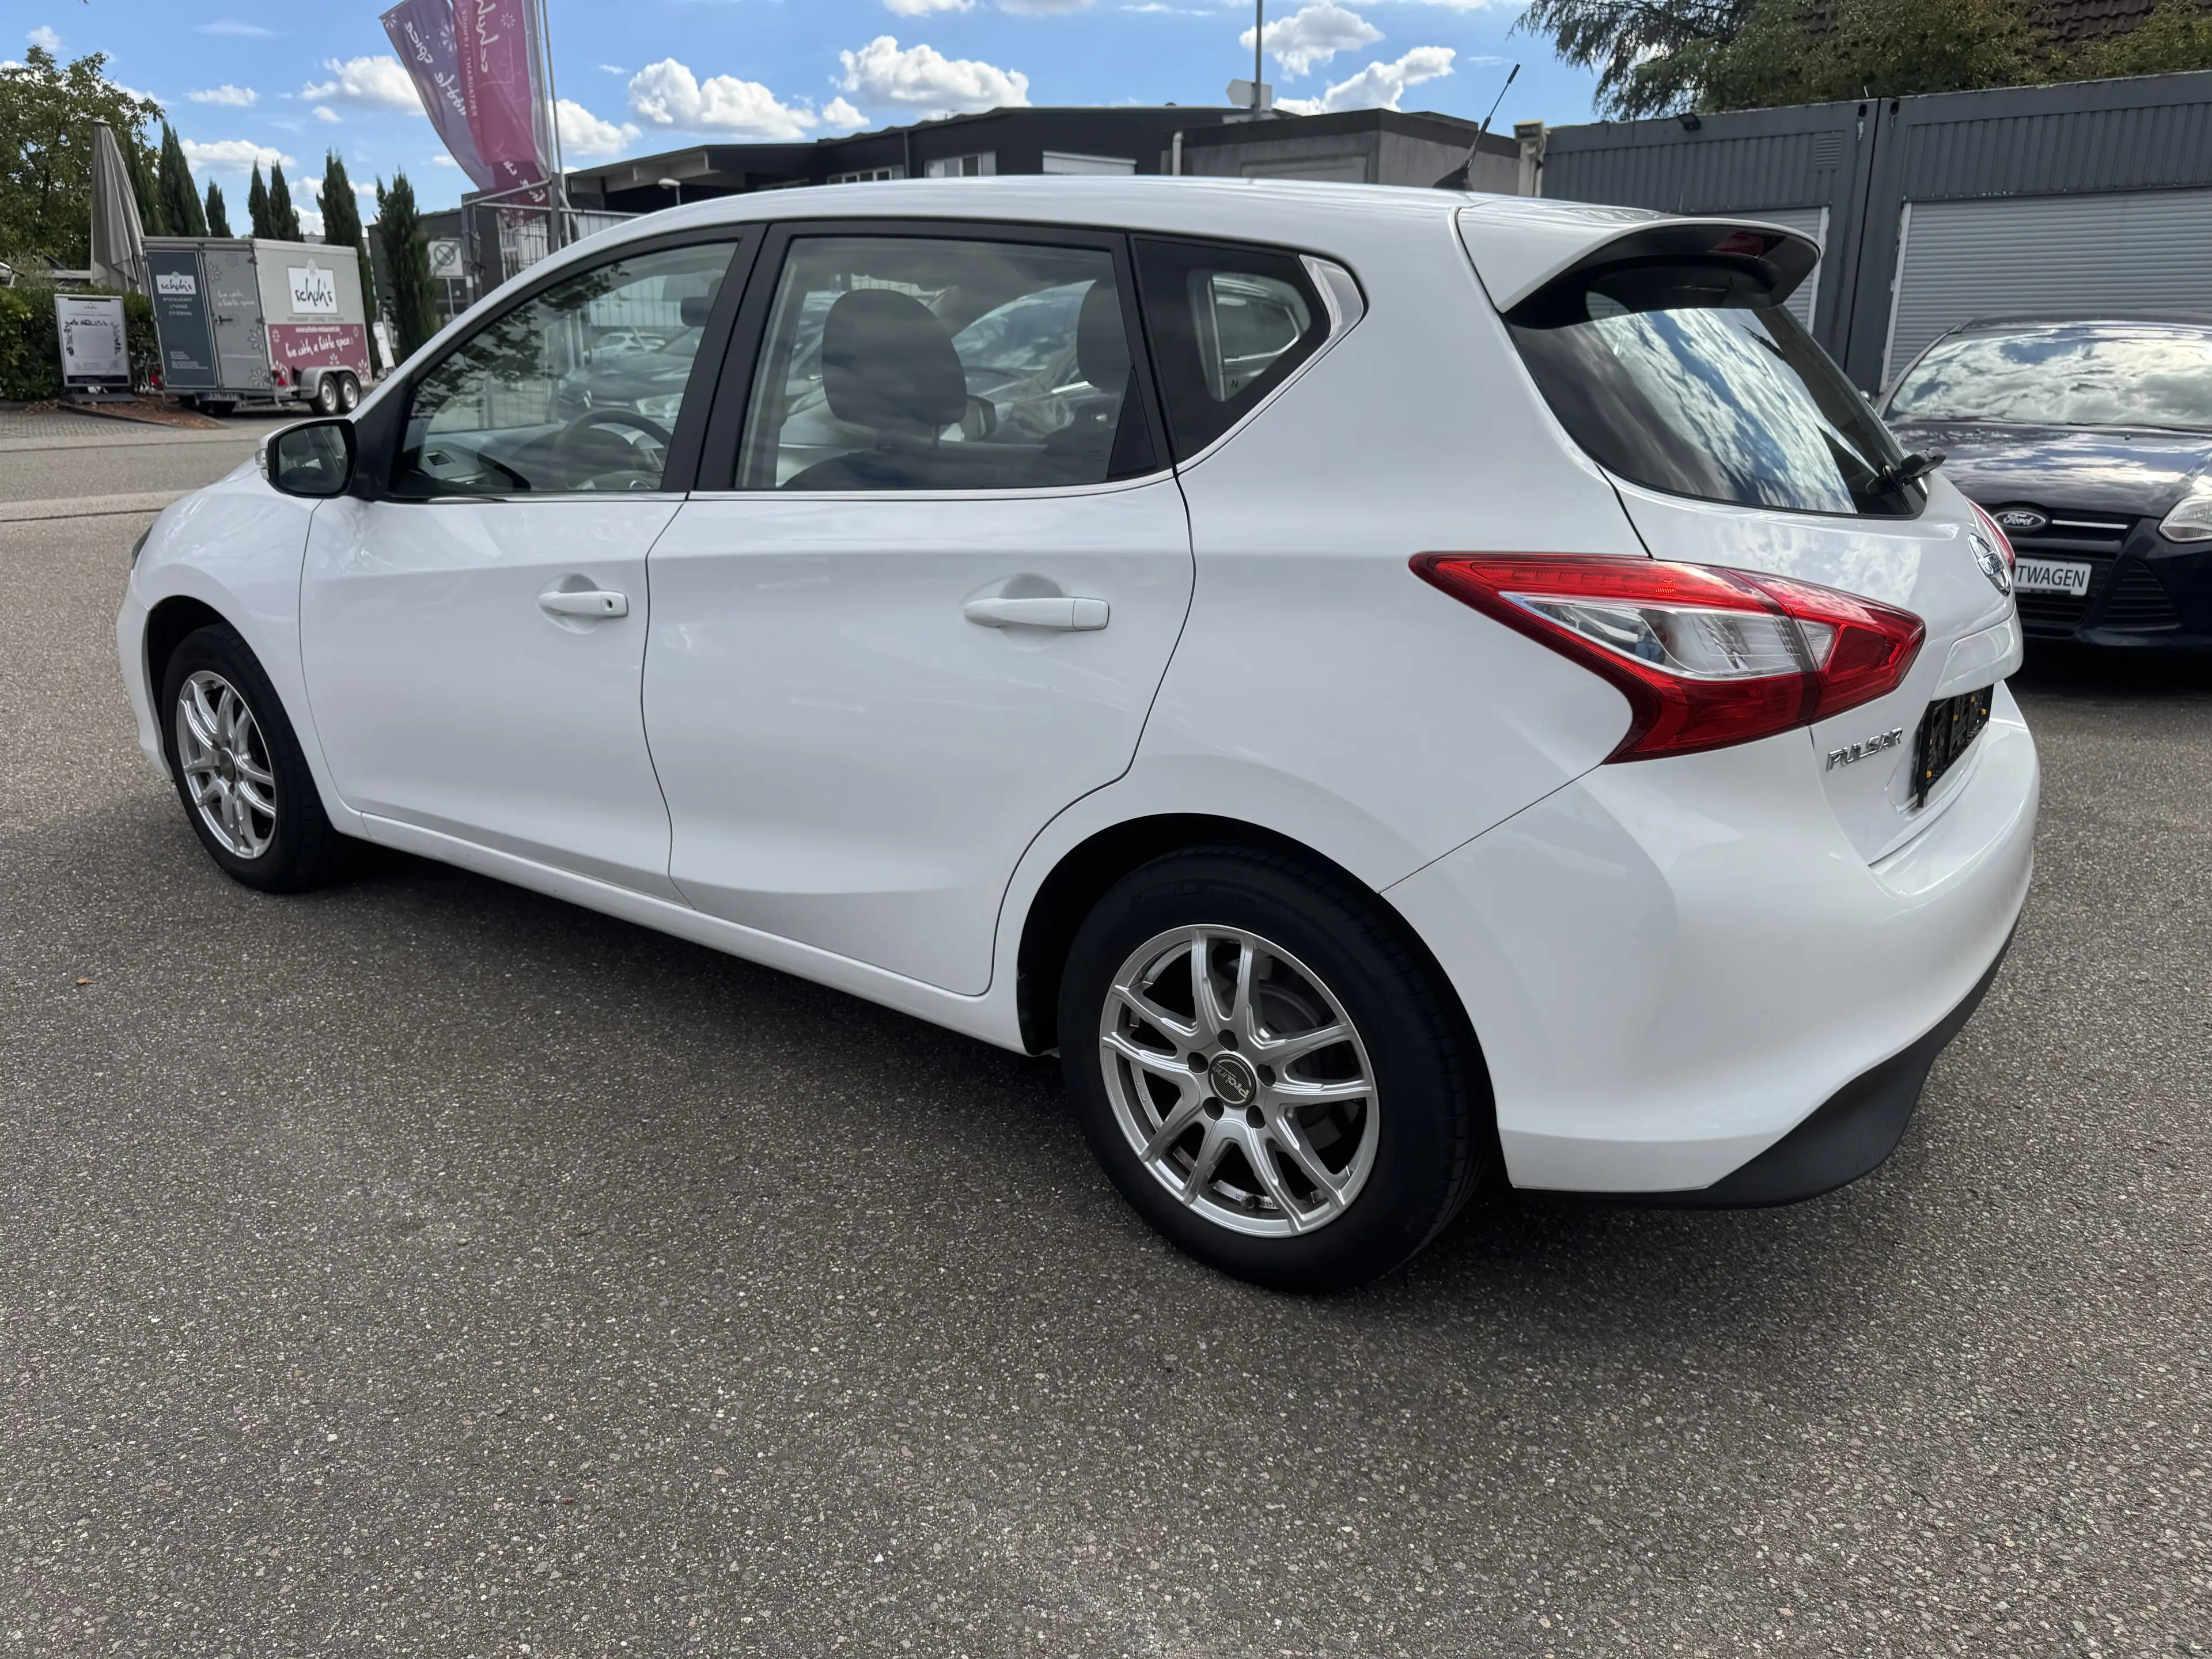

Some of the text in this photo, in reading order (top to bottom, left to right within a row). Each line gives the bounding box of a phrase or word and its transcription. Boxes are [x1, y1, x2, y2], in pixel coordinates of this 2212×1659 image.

[2003, 512, 2034, 525] Ford
[2017, 565, 2086, 588] TWAGEN
[1826, 726, 1903, 772] PULSAR
